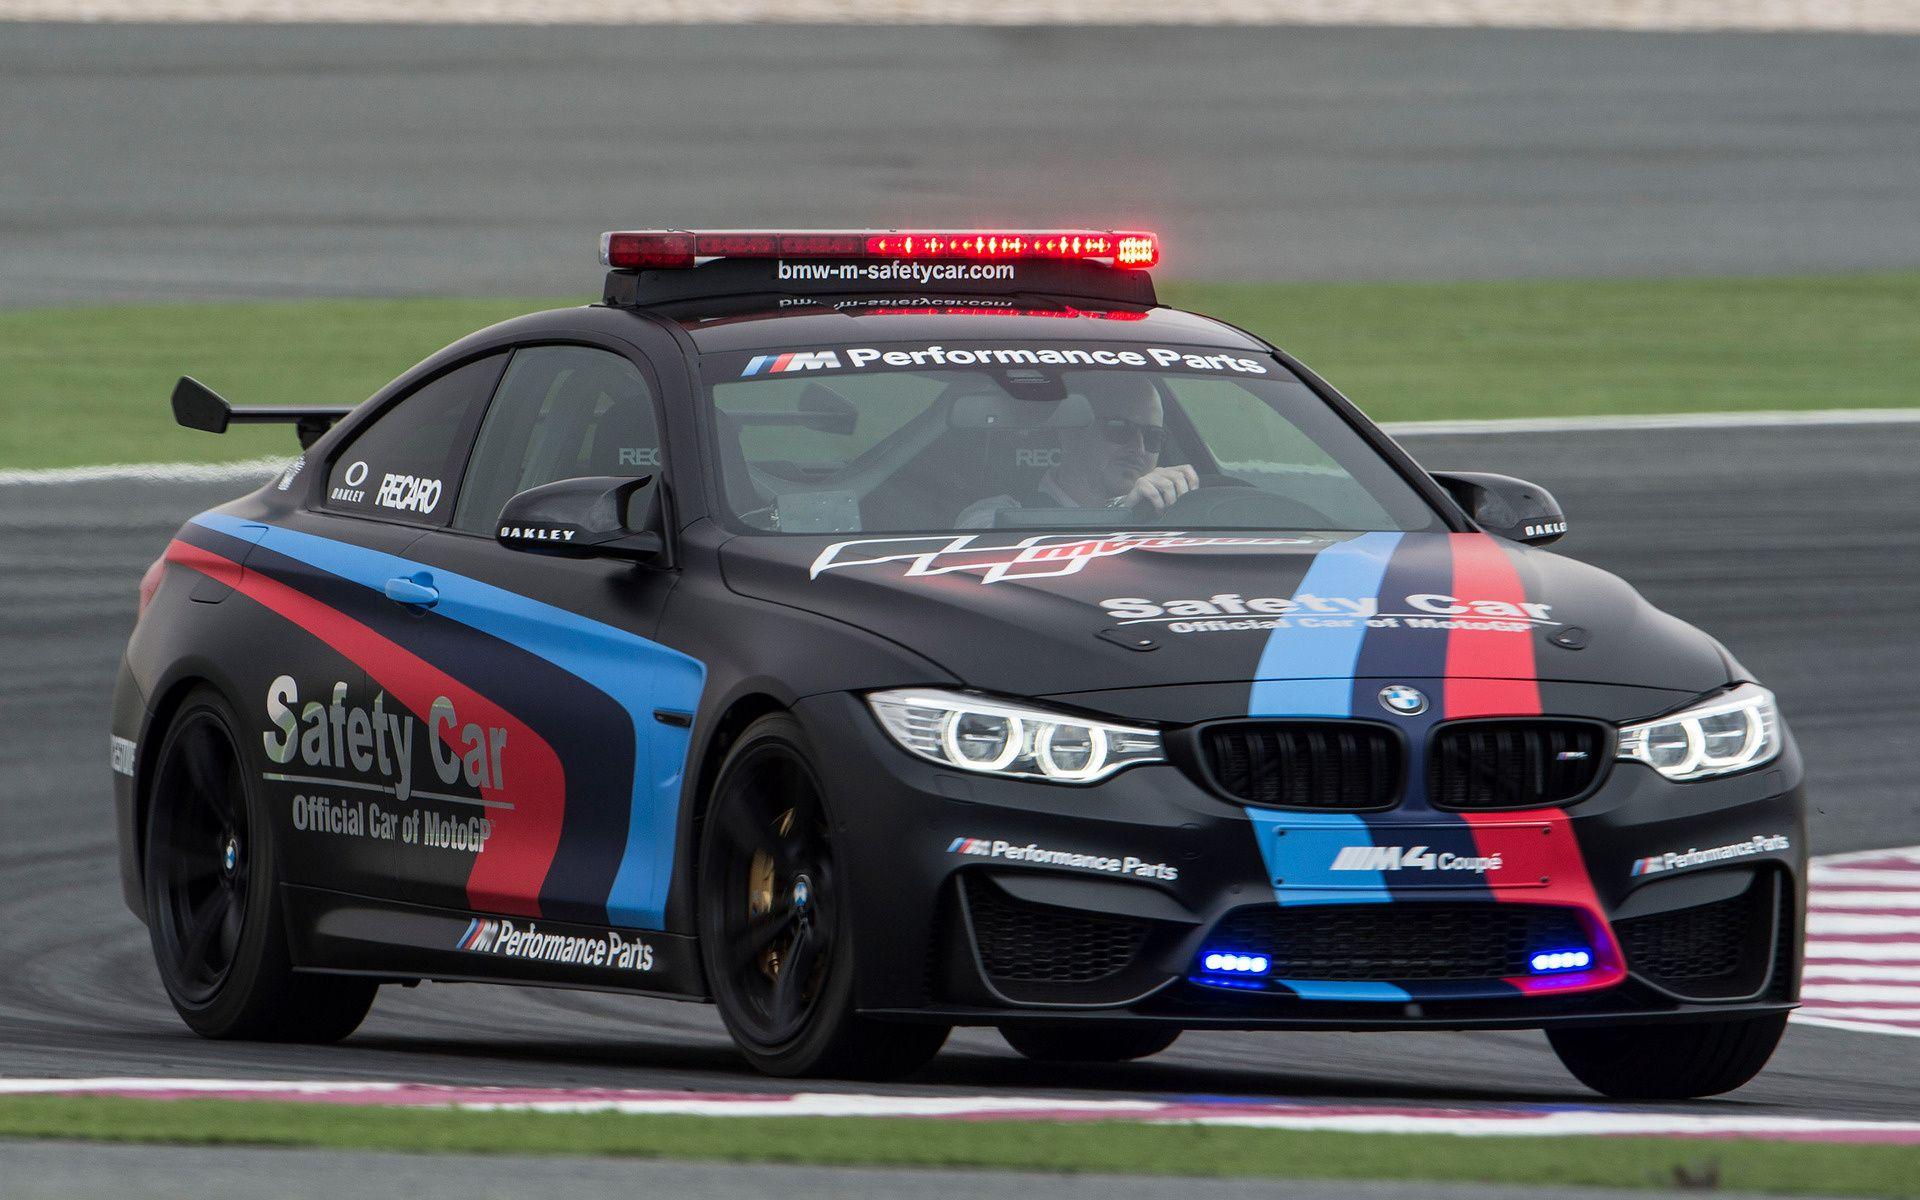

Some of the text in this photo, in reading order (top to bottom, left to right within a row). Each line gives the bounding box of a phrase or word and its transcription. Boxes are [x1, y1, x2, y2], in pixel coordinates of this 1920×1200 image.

[778, 260, 1014, 284] bmw-m-safetycar.com
[846, 345, 1147, 368] Performance
[1147, 348, 1267, 374] Parts
[618, 447, 661, 466] REC
[1015, 448, 1062, 467] REC
[331, 487, 365, 503] OAKLEY
[374, 473, 442, 514] RECARO
[500, 526, 576, 541] OAKLEY
[1525, 521, 1567, 537] OAKLE
[1099, 593, 1553, 620] Safety Car
[1167, 617, 1532, 634] Official Car of MotoGP
[262, 674, 510, 801] Safety Car
[292, 794, 492, 853] Official Car of MotoGP
[991, 840, 1122, 872] Performance
[1122, 856, 1179, 881] Parts
[1329, 846, 1503, 874] M4 Coupé
[1663, 842, 1757, 869] Performance
[1752, 834, 1790, 853] Parts
[493, 919, 606, 967] Performance
[606, 931, 654, 971] Parts
